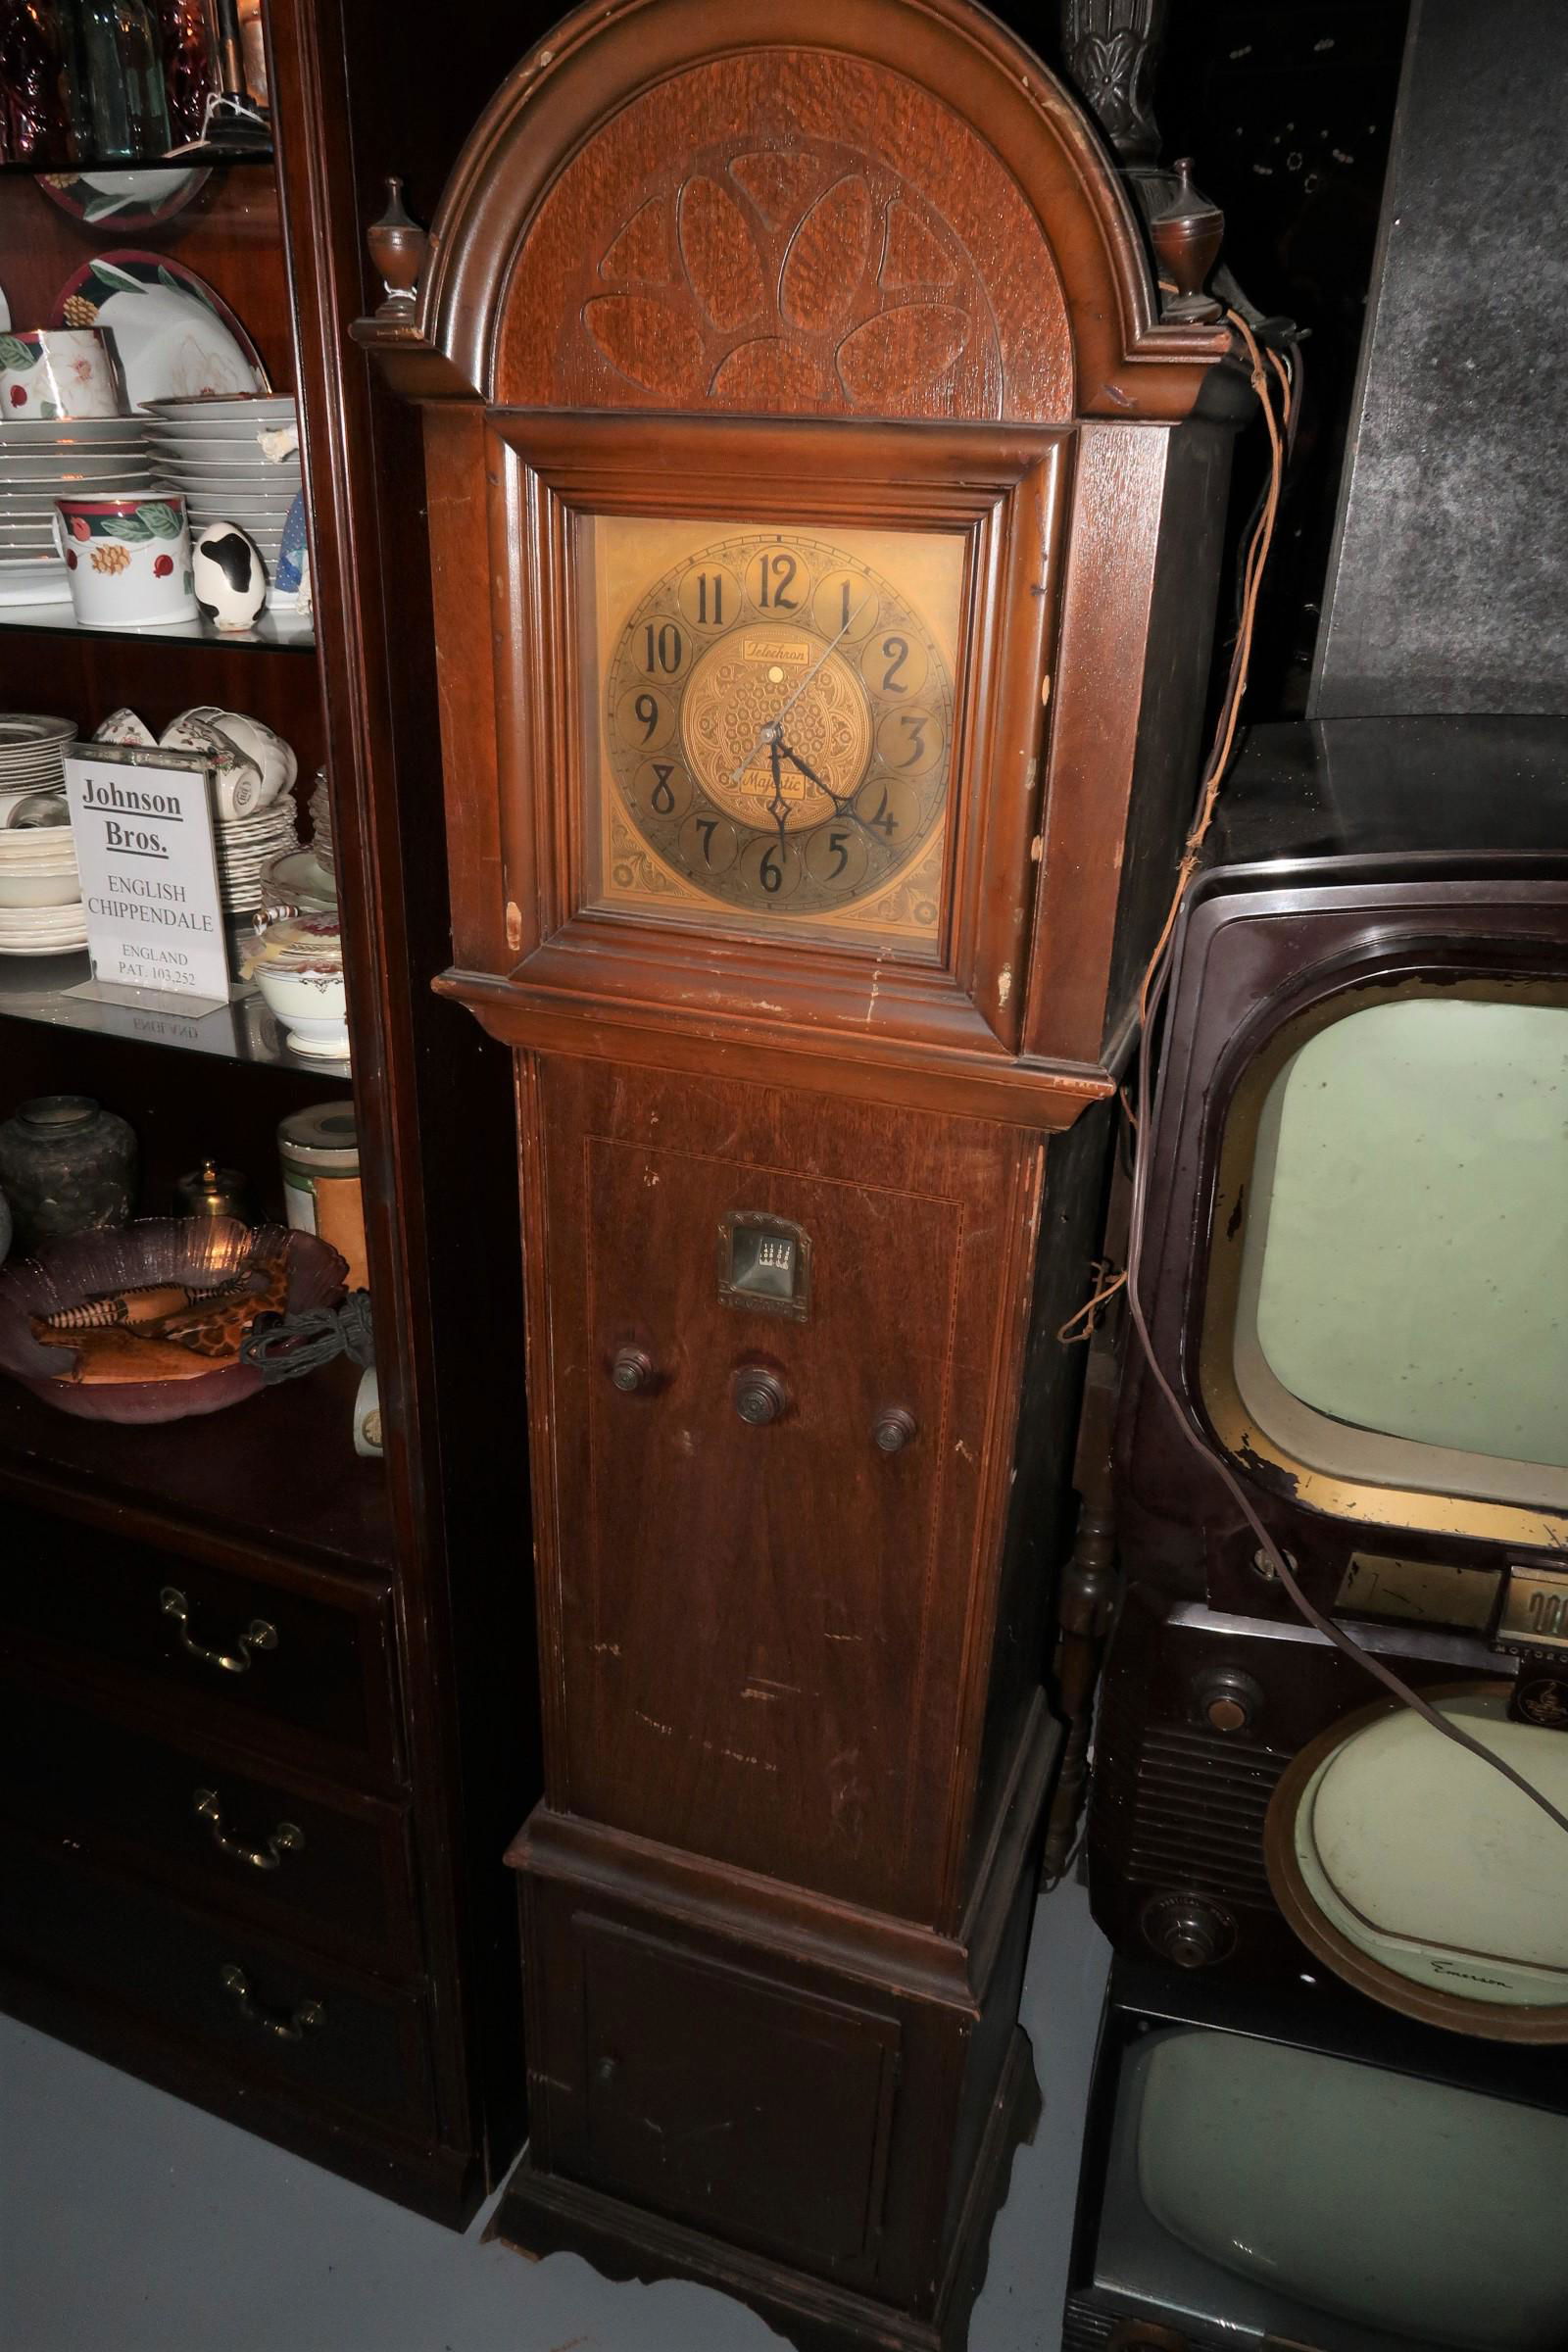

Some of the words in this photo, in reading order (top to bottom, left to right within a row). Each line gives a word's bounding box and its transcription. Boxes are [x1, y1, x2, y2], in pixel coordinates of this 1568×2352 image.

[697, 572, 723, 625] 11
[760, 554, 799, 609] 12
[840, 579, 852, 635] 1
[644, 623, 682, 673] 10
[746, 642, 805, 661] Telechron
[883, 636, 909, 693] 2
[634, 693, 659, 744] 9
[898, 716, 929, 767] 3
[82, 779, 181, 814] Johnson
[651, 764, 675, 815] 8
[869, 785, 900, 836] 4
[104, 820, 167, 853] Bros.
[696, 818, 720, 871] 7
[829, 833, 850, 880] 5
[109, 874, 186, 903] ENGLISH
[760, 846, 782, 893] 6
[88, 899, 214, 932] CHIPPENDALE
[119, 961, 148, 978] PAT.
[152, 967, 196, 986] 103,252
[122, 944, 188, 966] ENGLAND
[1431, 1960, 1513, 1989] Emerson
